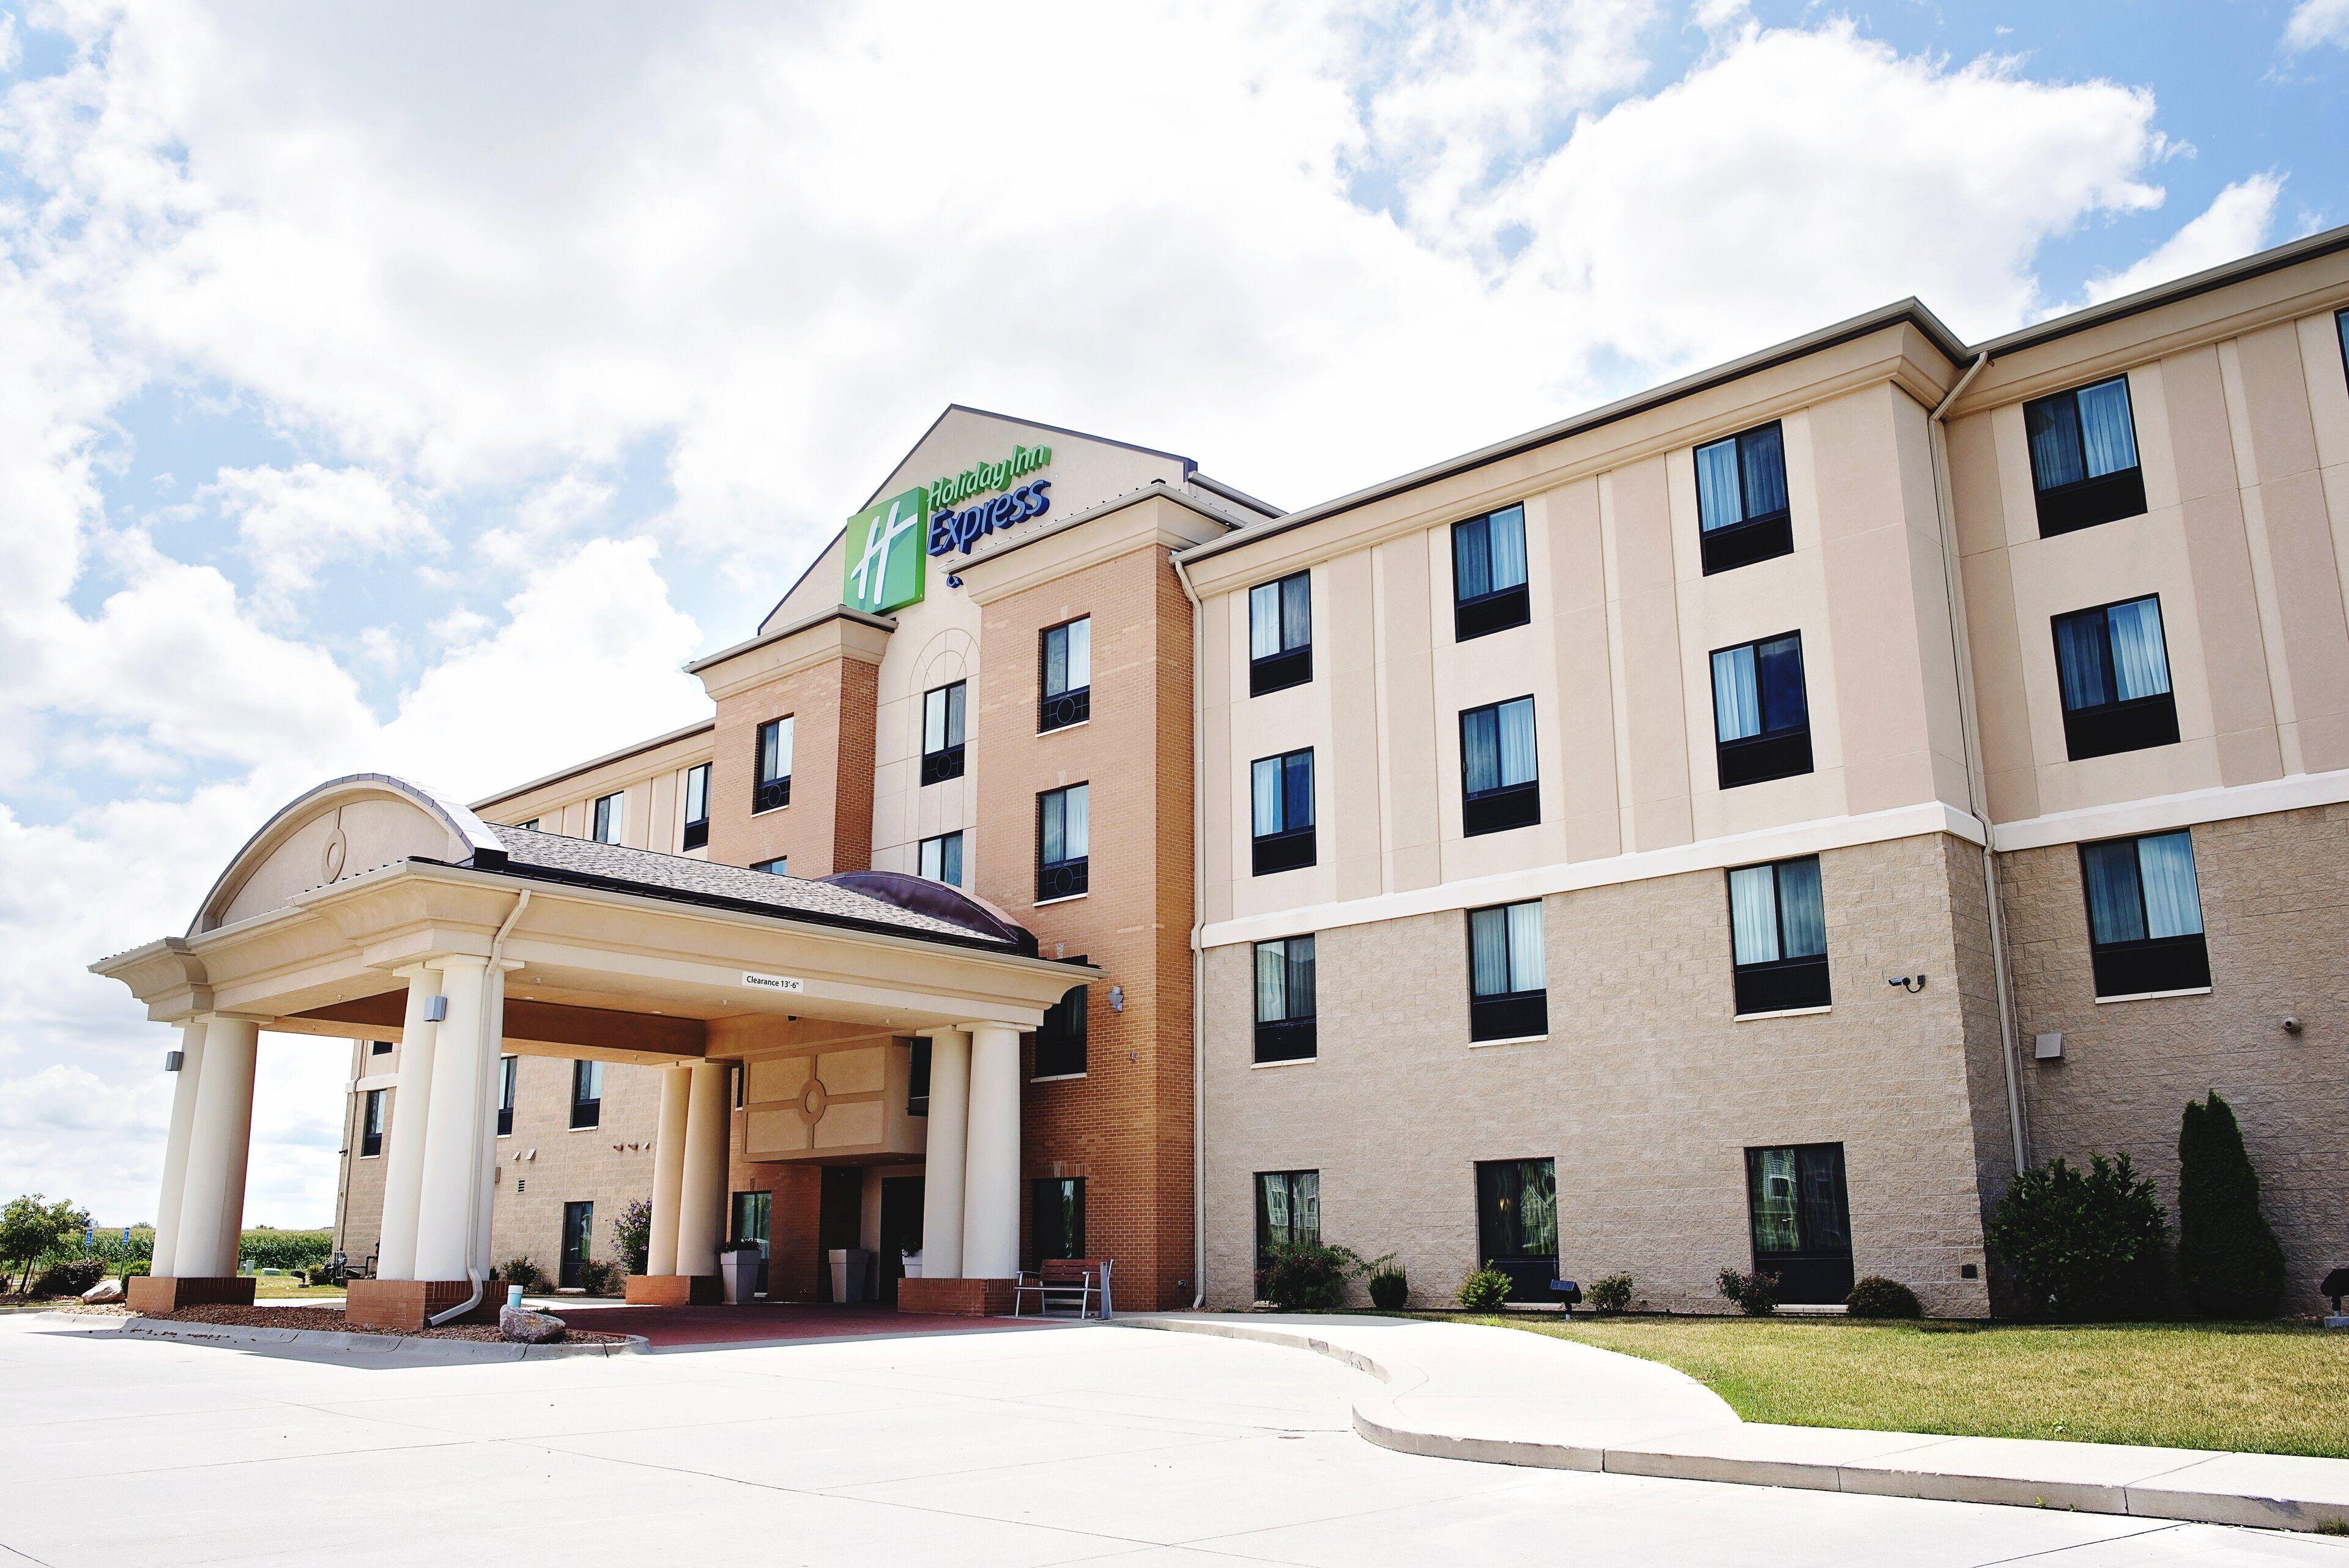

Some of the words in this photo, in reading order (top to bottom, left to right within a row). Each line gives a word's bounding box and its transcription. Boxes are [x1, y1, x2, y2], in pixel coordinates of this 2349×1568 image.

[927, 460, 1011, 512] Holiday
[1009, 444, 1052, 478] Inn
[926, 480, 1052, 557] Express
[746, 976, 779, 986] Clearance
